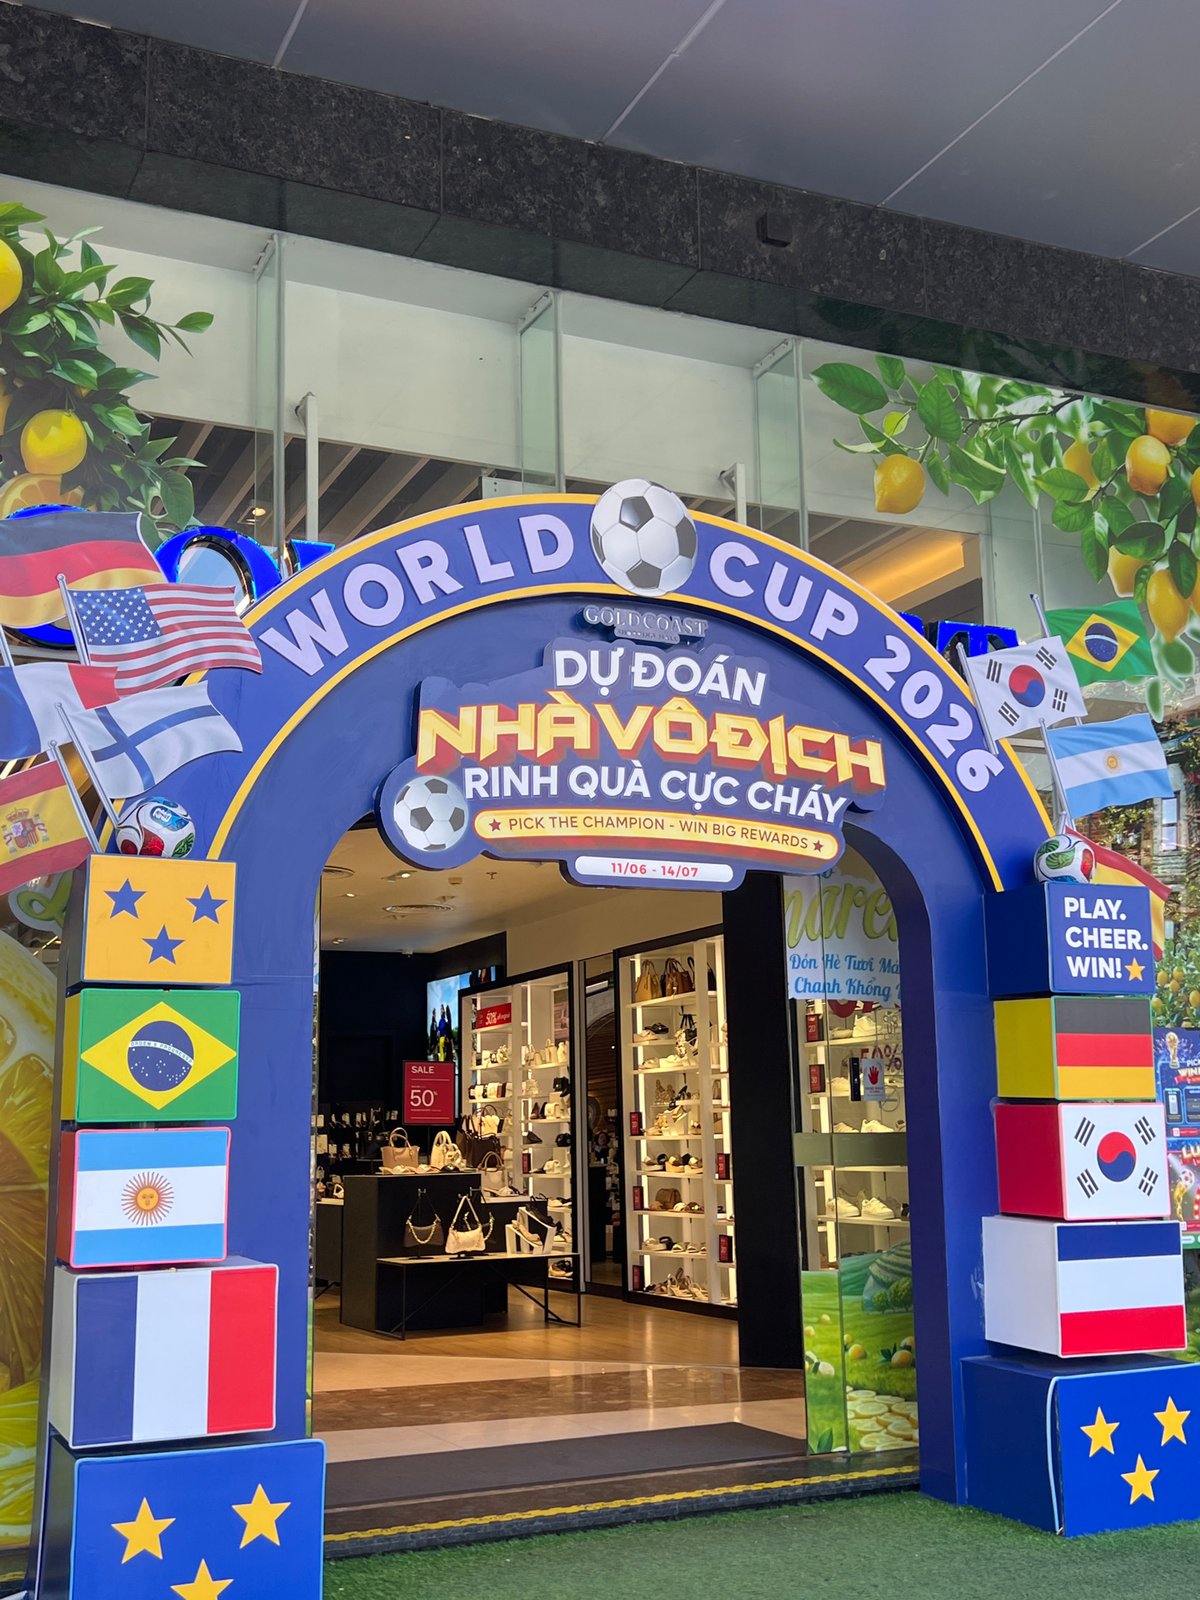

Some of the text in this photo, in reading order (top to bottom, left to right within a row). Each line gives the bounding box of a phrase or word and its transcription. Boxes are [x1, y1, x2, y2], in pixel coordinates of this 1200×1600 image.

[258, 514, 574, 676] WORLD
[709, 541, 859, 641] CUP
[864, 635, 1004, 792] 2026
[555, 647, 766, 706] DỰ ĐOÁN
[417, 690, 886, 786] NHÀ VÔ ĐỊCH
[464, 760, 847, 823] RINH QUÀ CỰC CHÁY
[508, 817, 545, 831] PICK
[549, 816, 578, 829] THE
[583, 816, 665, 830] CHAMPION
[679, 820, 708, 834] WIN
[712, 824, 736, 837] BIG
[740, 829, 808, 849] REWARDS
[611, 862, 647, 875] 11/06
[660, 865, 699, 878] 14/07
[1064, 897, 1127, 921] PLAY.
[1065, 926, 1149, 951] CHEER.
[789, 954, 818, 970] Đón
[823, 954, 840, 969] Hè
[845, 954, 874, 972] Tươi
[1066, 956, 1122, 979] WIN!
[794, 977, 842, 994] Chanh
[411, 1066, 435, 1074] SALE
[1186, 1059, 1200, 1067] PIC
